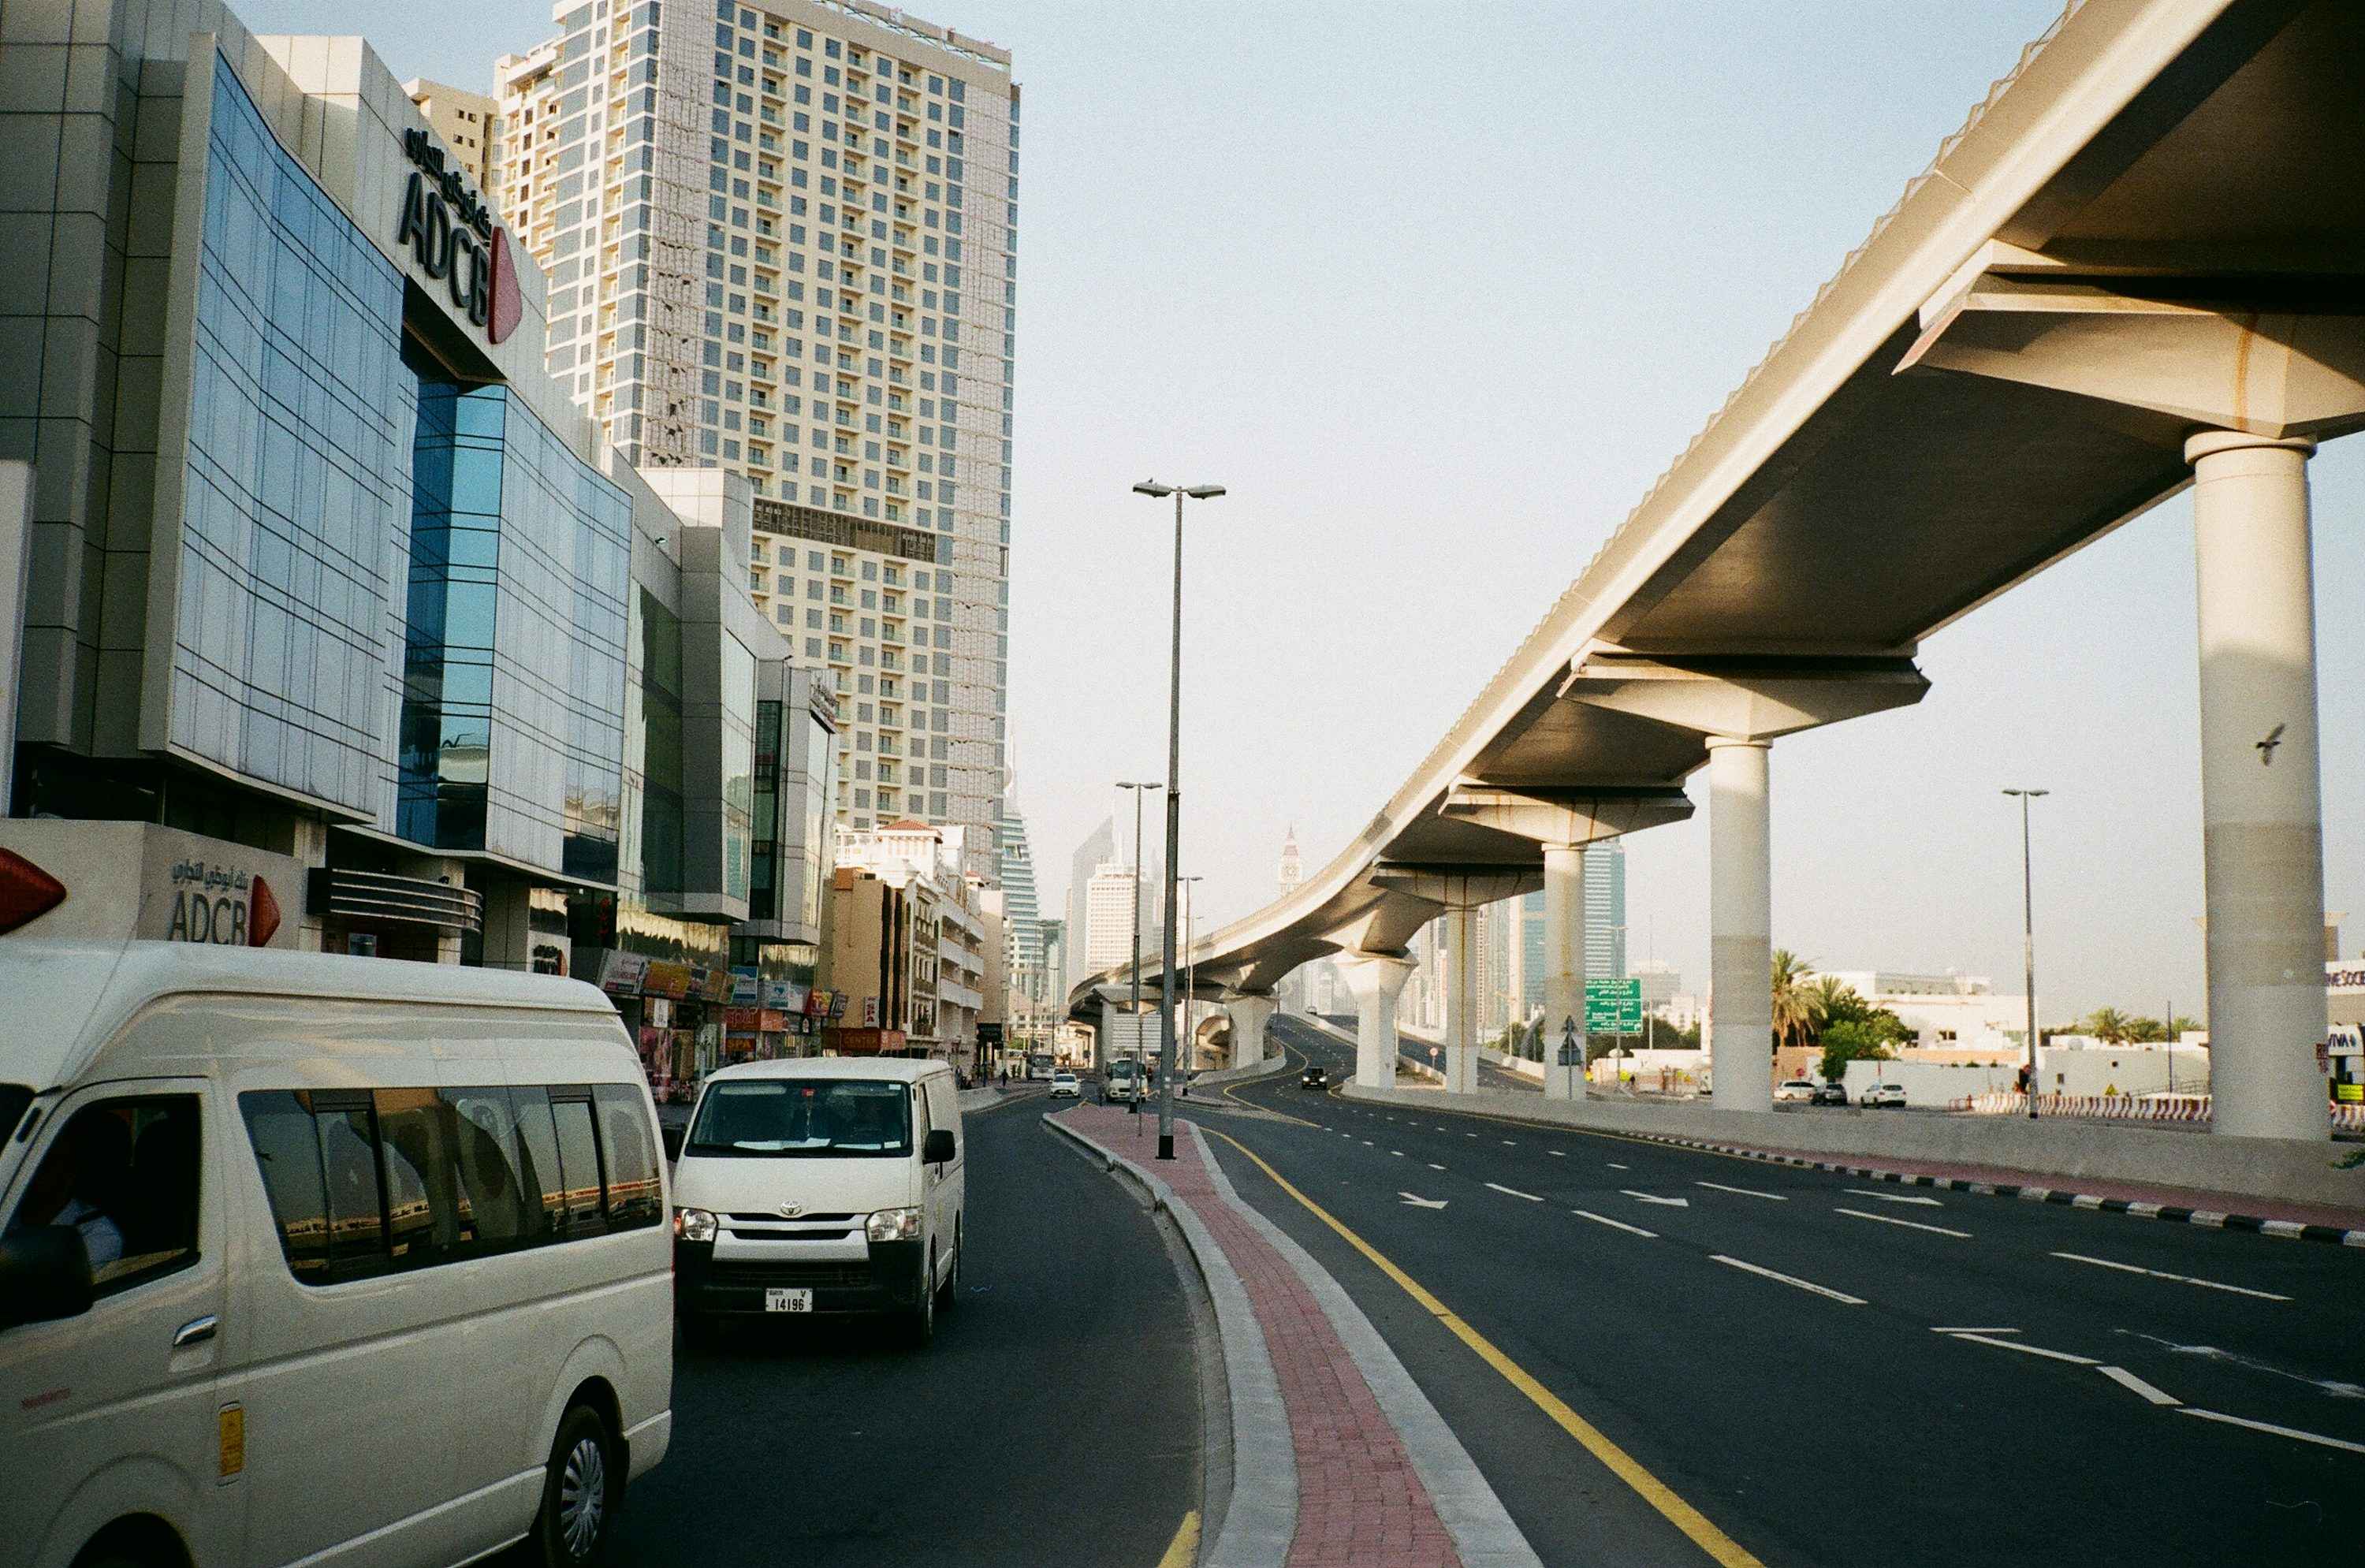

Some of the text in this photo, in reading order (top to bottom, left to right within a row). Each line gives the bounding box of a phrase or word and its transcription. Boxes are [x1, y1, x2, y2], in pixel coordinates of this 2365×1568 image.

[398, 171, 490, 327] ADCB
[165, 888, 246, 946] ADCB
[776, 1298, 804, 1311] 14196
